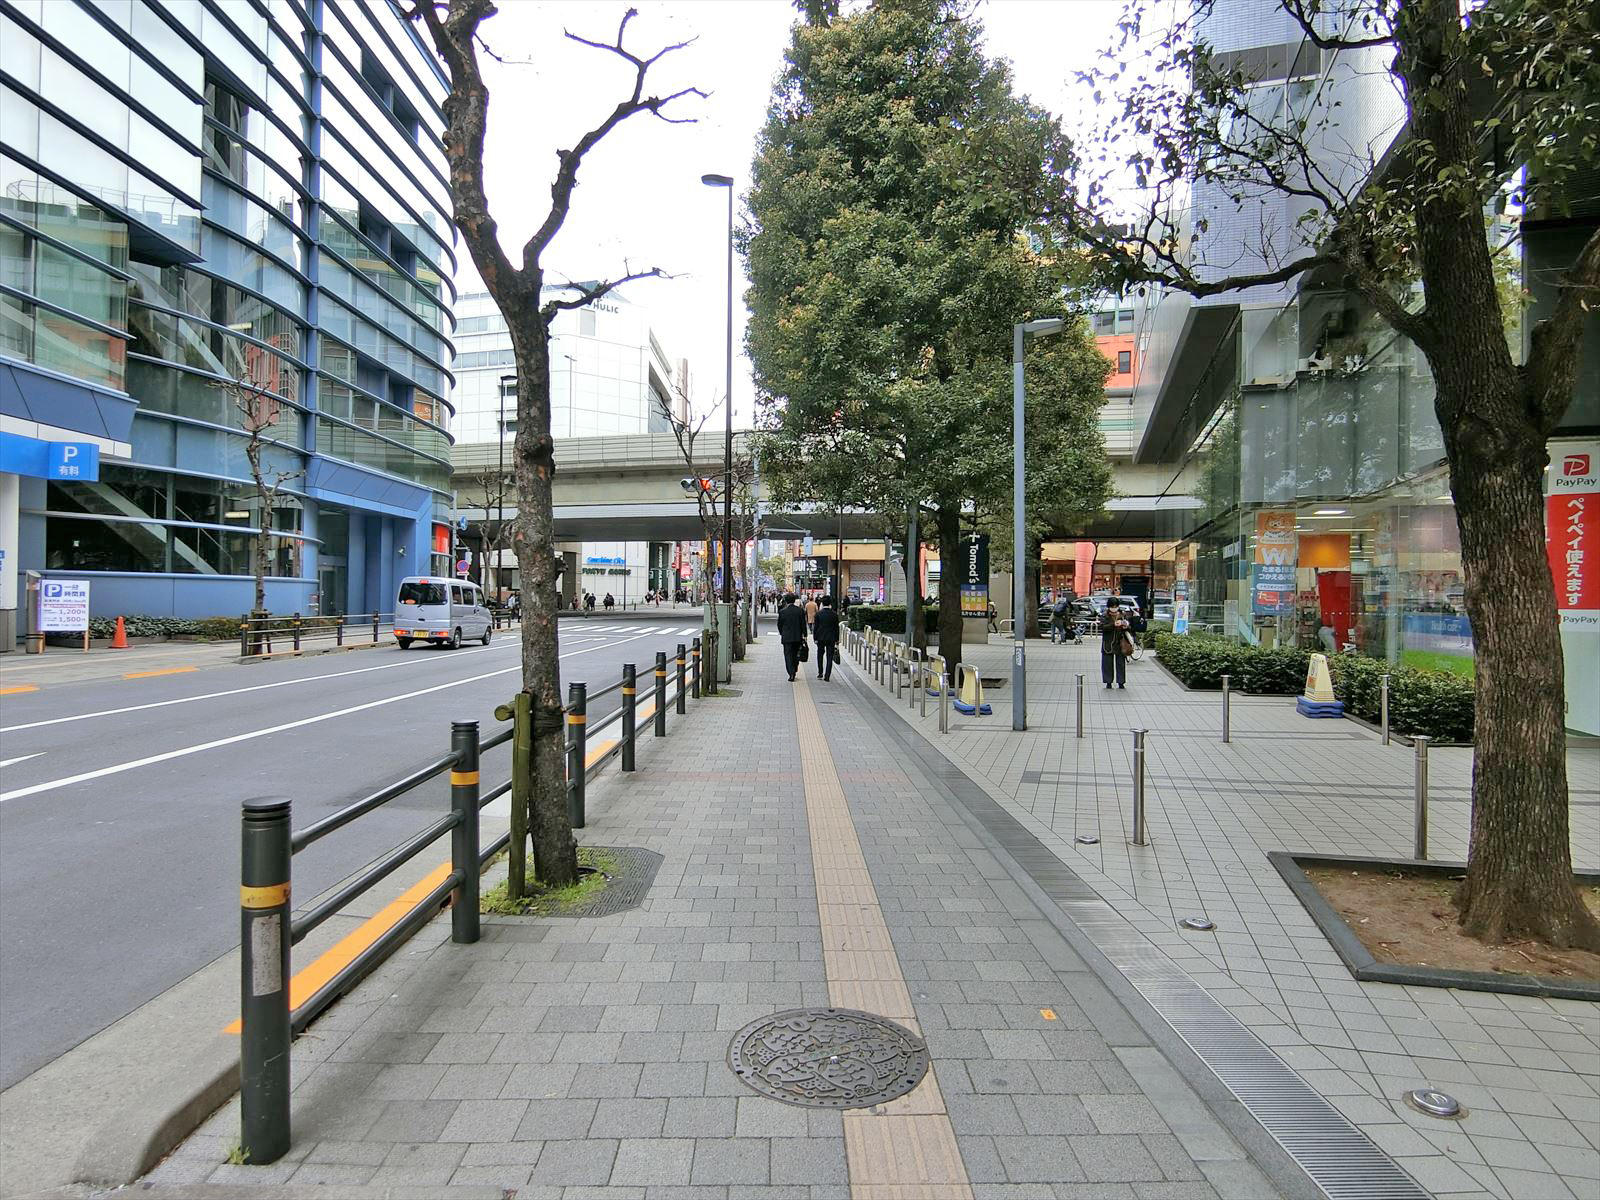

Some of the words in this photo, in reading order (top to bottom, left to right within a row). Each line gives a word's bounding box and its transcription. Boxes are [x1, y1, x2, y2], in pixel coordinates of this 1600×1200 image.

[593, 301, 619, 314] HULIC
[64, 446, 78, 463] P
[59, 465, 79, 476] 有料
[1556, 477, 1597, 488] PayPay
[1565, 497, 1585, 606] ペイペイ使えます
[48, 585, 61, 597] P
[1563, 615, 1598, 624] PayPay
